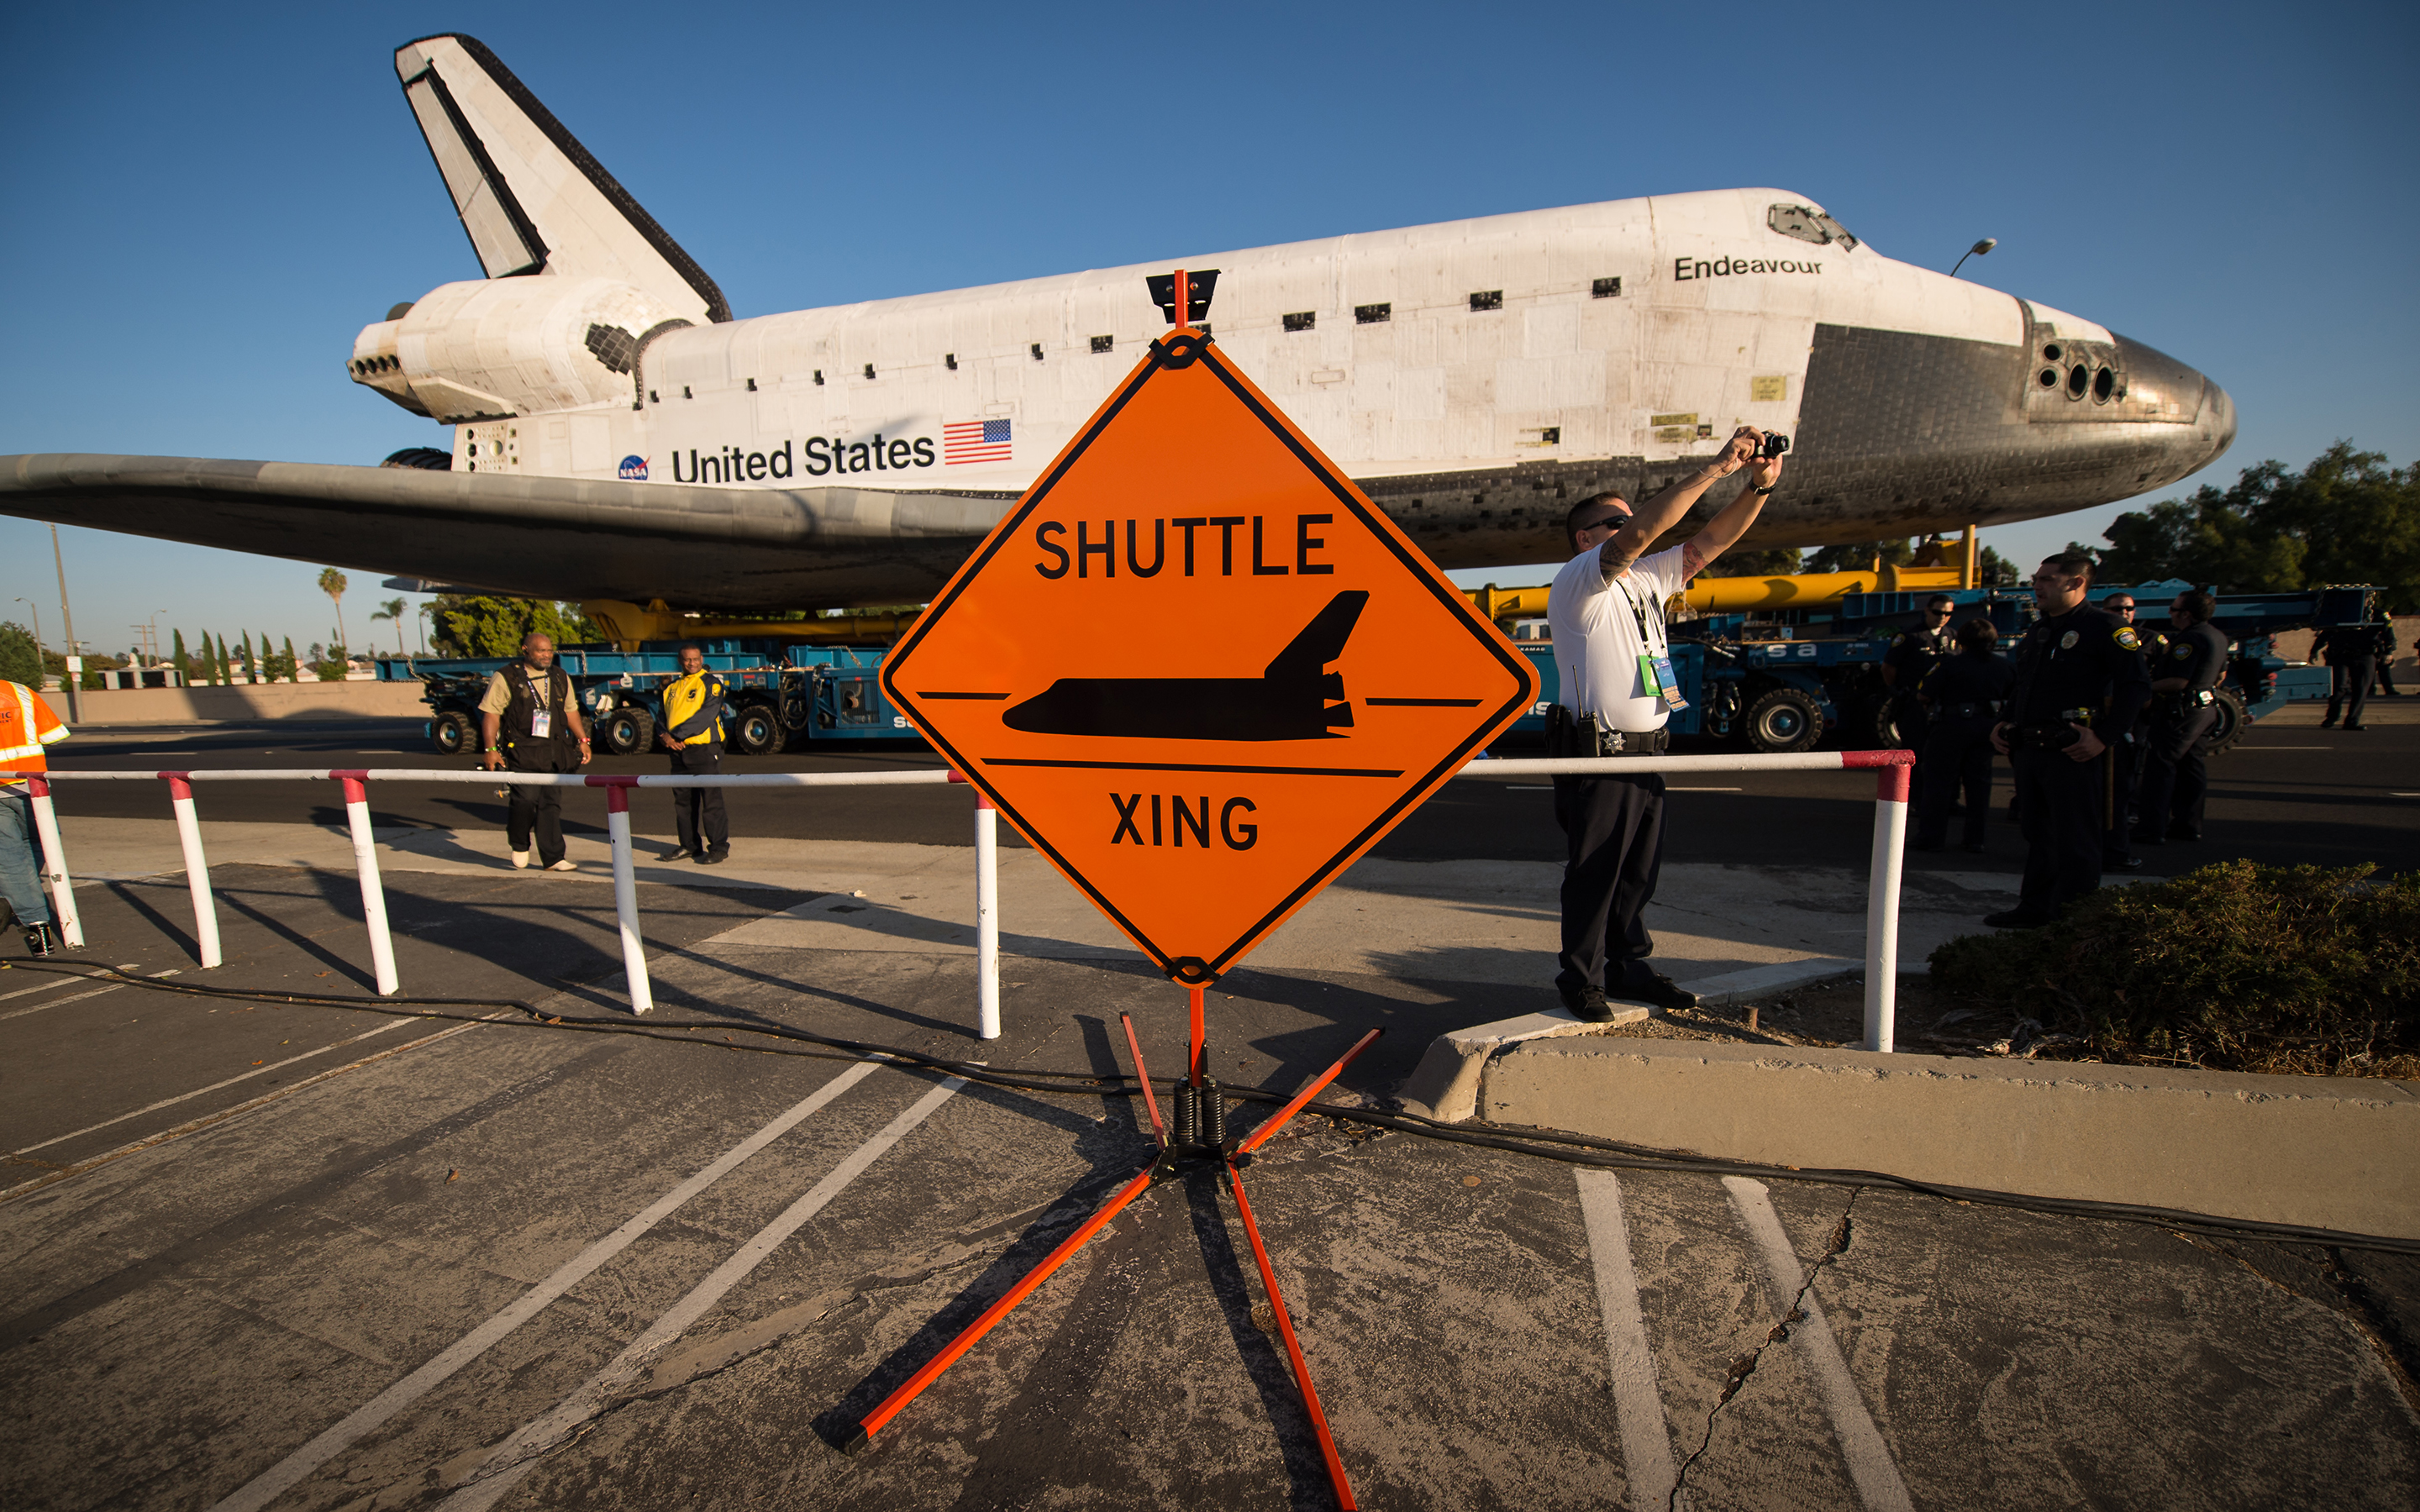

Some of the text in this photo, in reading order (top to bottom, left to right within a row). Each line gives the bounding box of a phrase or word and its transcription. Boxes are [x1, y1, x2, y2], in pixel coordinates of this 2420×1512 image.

[1675, 255, 1822, 282] Endeavour
[618, 468, 648, 478] NASA
[672, 433, 936, 484] United States
[1034, 514, 1334, 580] SHUTTLE
[1108, 792, 1259, 852] XING
